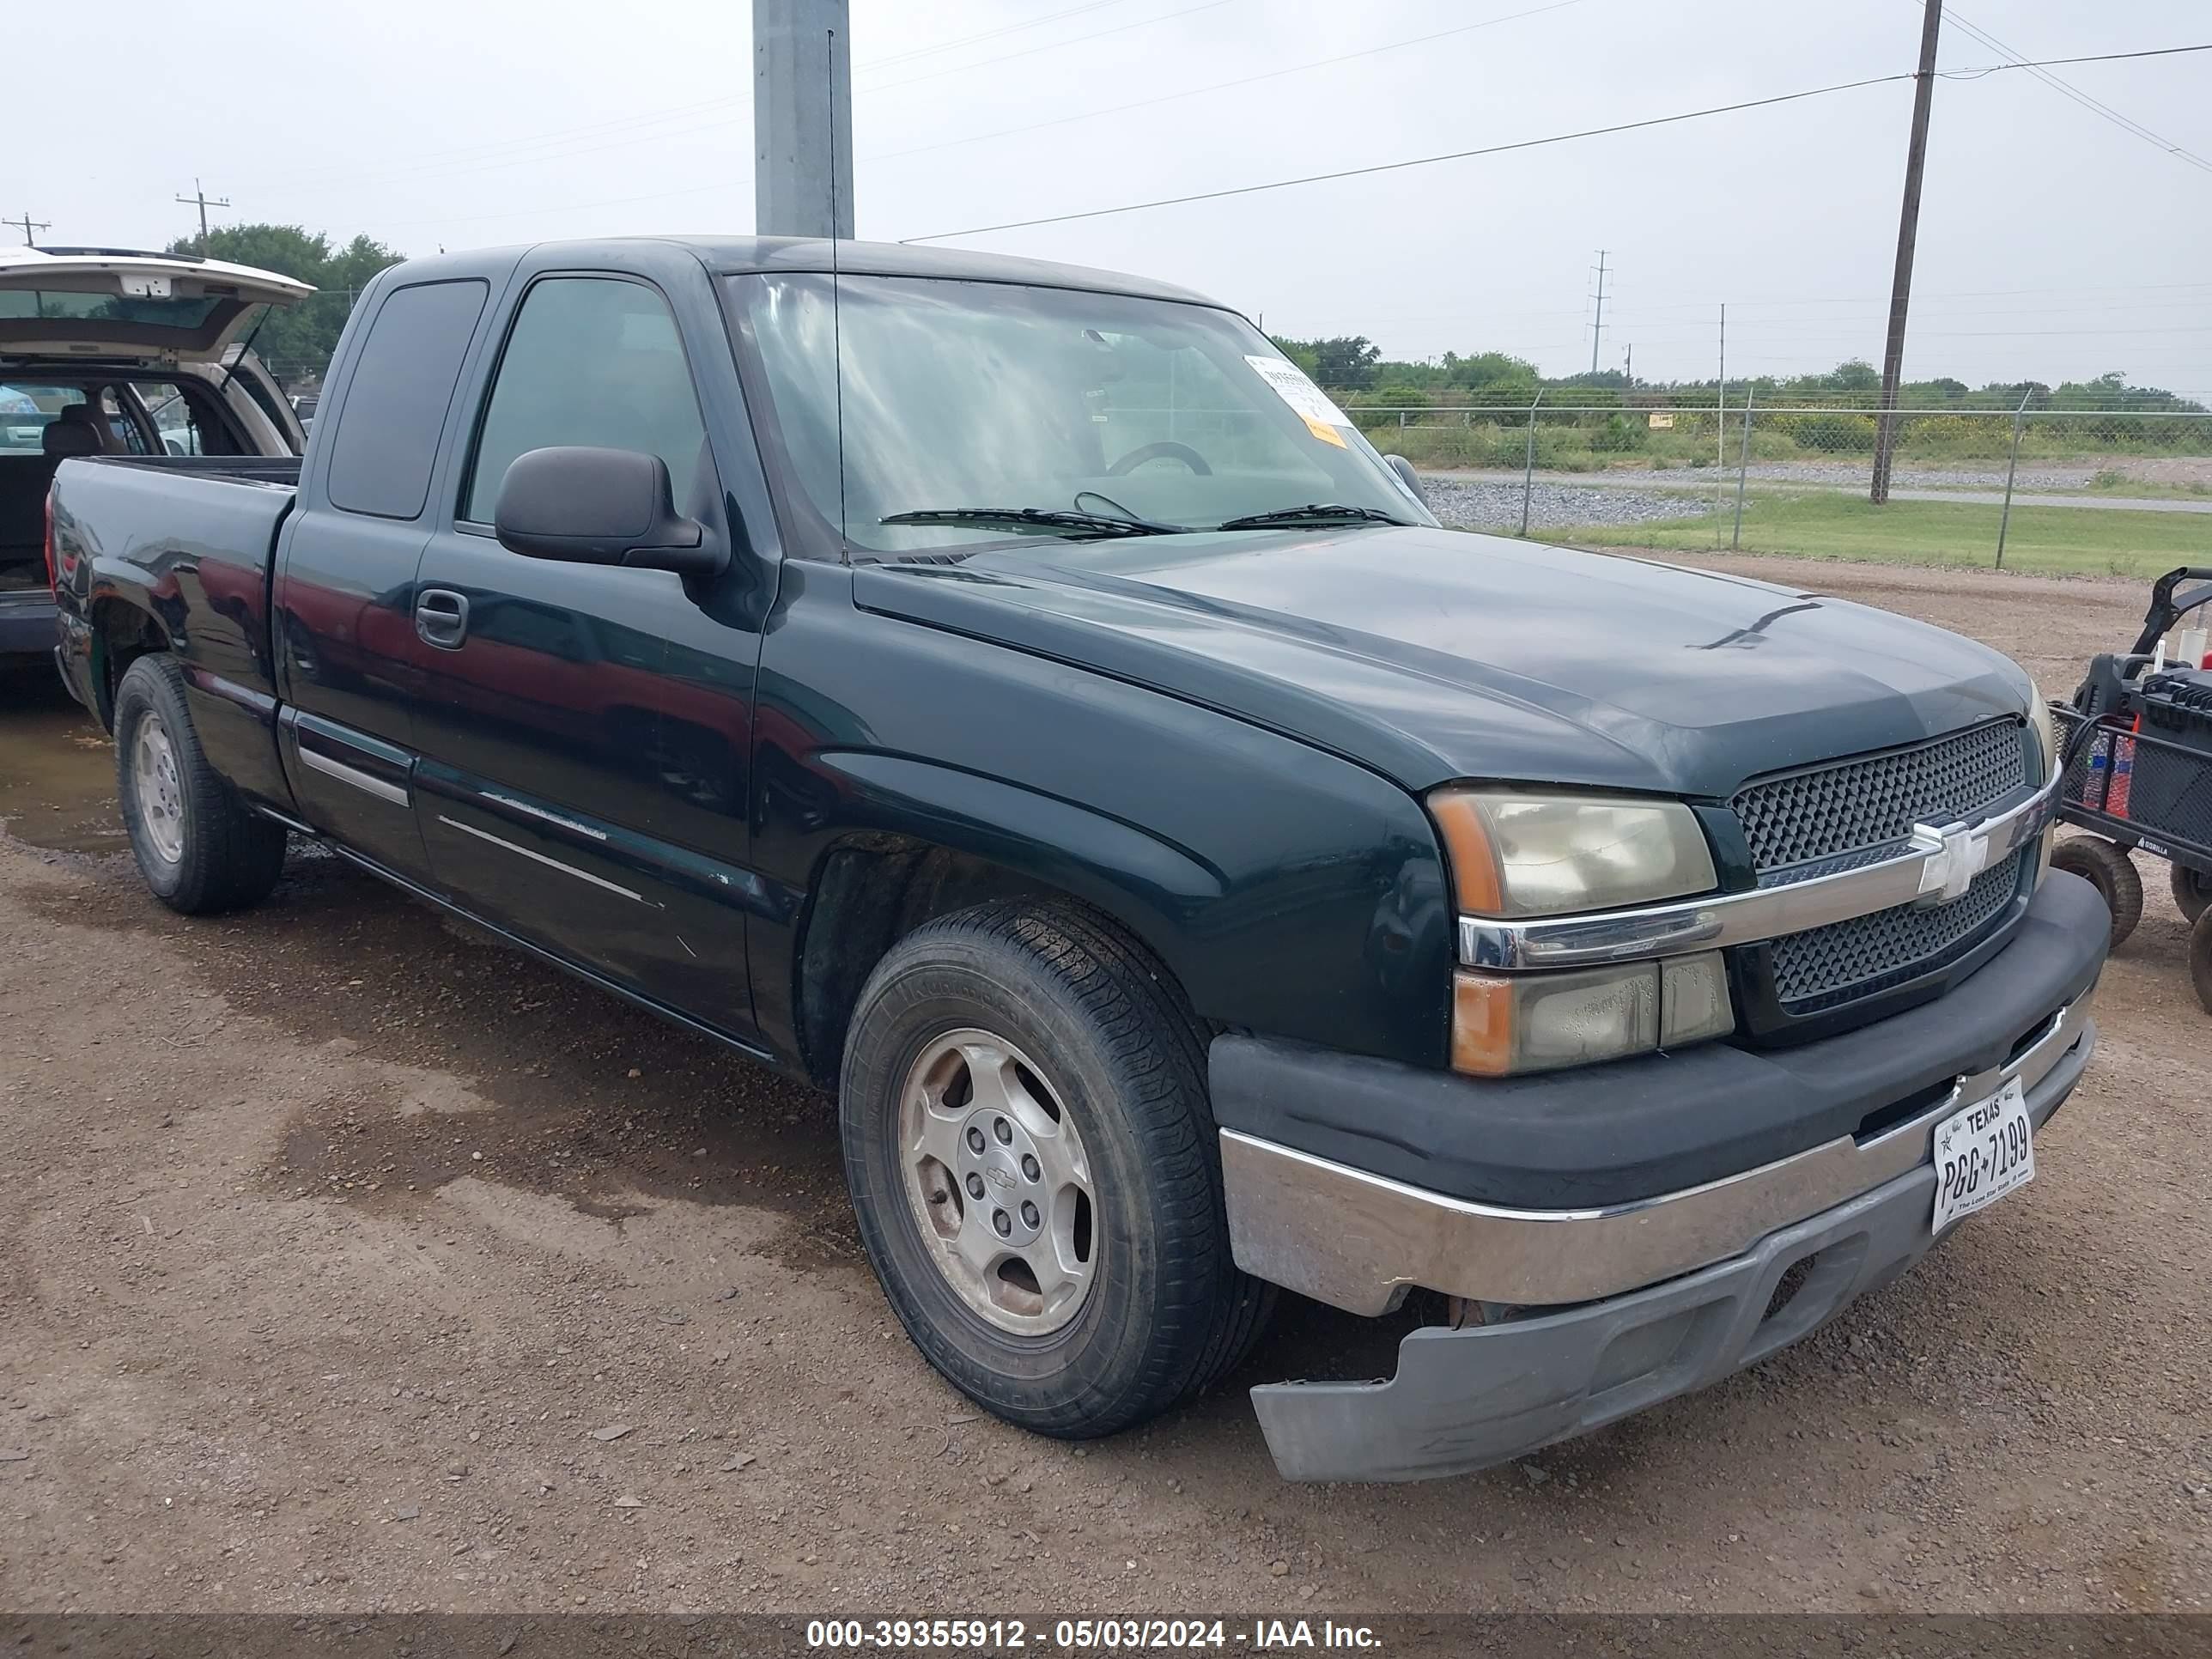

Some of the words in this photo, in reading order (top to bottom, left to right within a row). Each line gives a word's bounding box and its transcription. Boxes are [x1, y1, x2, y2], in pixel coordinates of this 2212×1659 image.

[2145, 842, 2168, 855] GORILLA
[1967, 1098, 2001, 1135] TEXAS
[1972, 1194, 1986, 1205] Lone
[1986, 1188, 1997, 1198] Star
[1997, 1181, 2010, 1192] State
